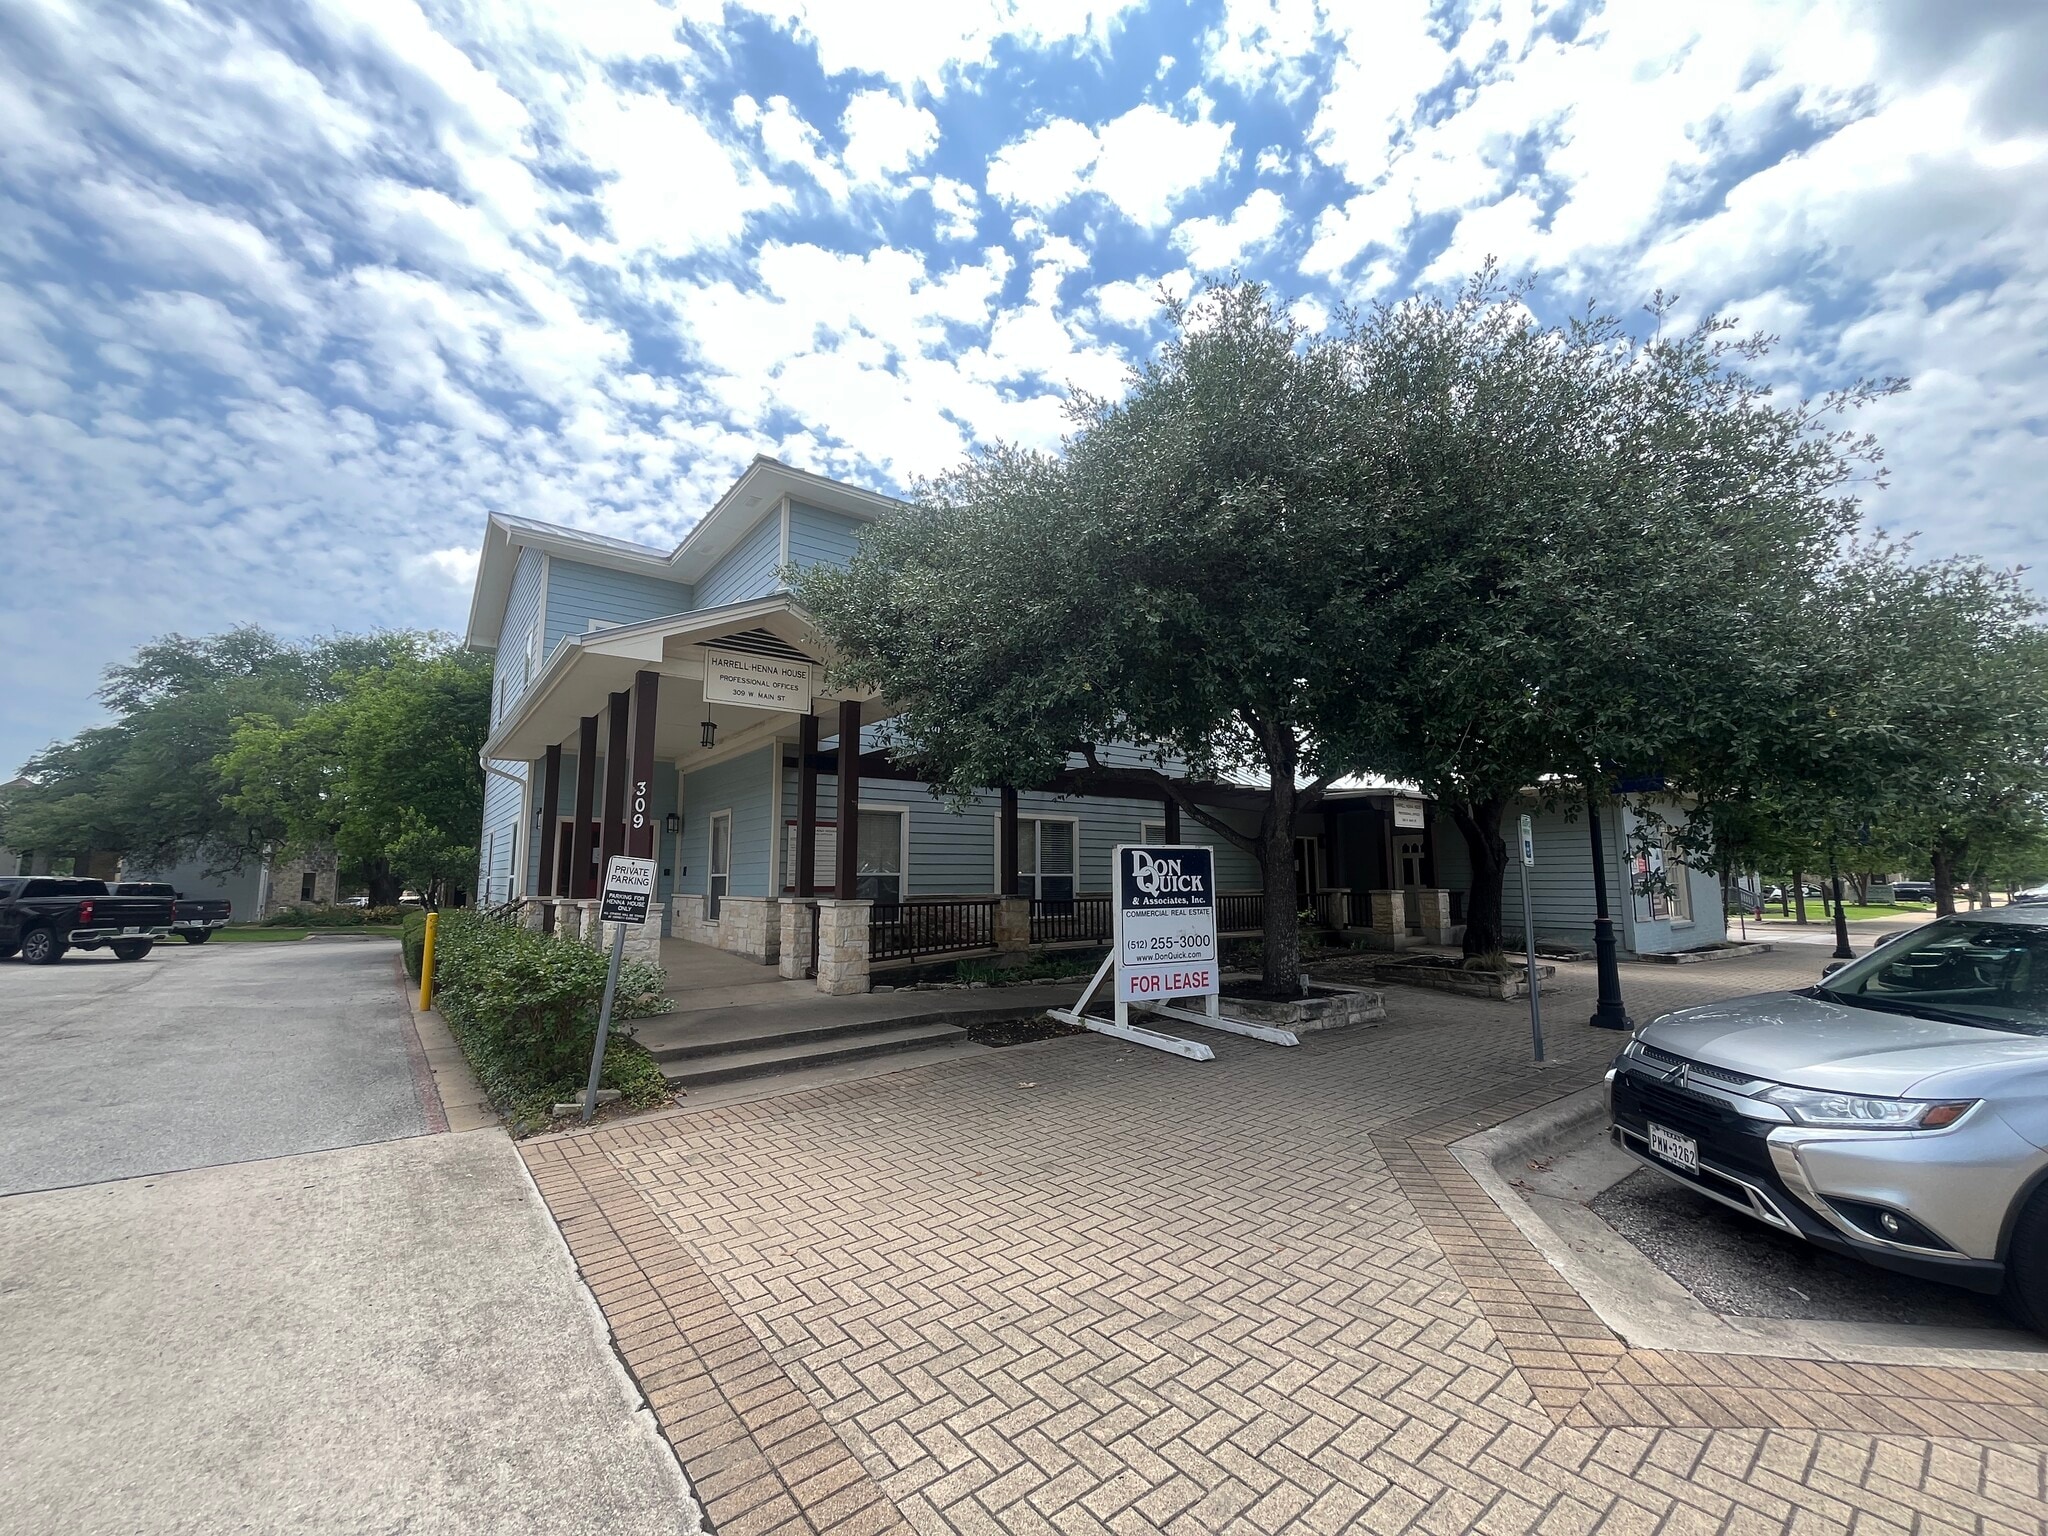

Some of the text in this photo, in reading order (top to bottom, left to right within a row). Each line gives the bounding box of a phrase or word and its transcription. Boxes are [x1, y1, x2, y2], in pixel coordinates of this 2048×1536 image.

[711, 657, 807, 679] HARRELL-HENNA HOUSE
[719, 675, 799, 691] PROFESSIONAL OFFICES
[757, 692, 775, 700] MAIN
[633, 781, 646, 829] 309
[614, 865, 650, 877] PRIVATE
[610, 874, 649, 886] PARKING
[608, 892, 632, 900] PARKING
[1132, 895, 1206, 906] & Associates, Inc.
[1126, 910, 1169, 918] COMMERCIAL
[1188, 908, 1210, 916] ESTATE
[1127, 934, 1211, 951] (512) 255-3000
[1136, 951, 1202, 962] www.DonQuick.com
[1130, 970, 1210, 994] FOR LEASE
